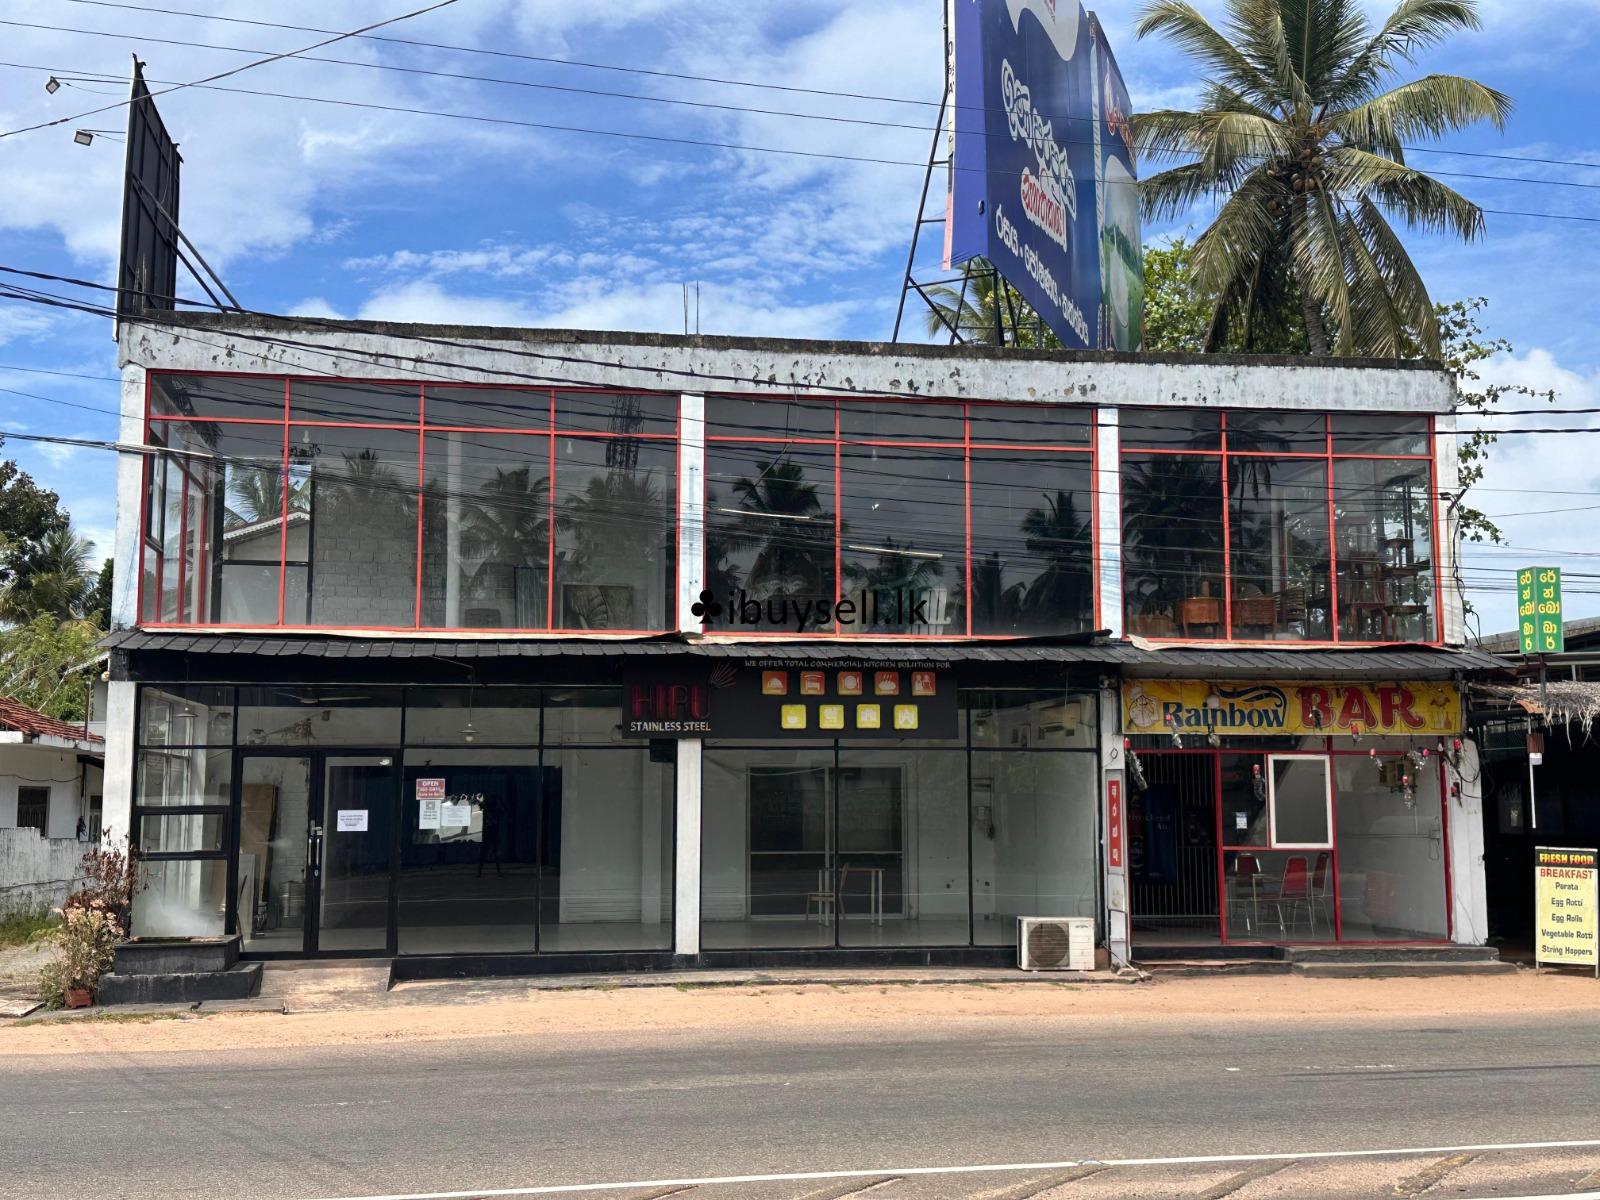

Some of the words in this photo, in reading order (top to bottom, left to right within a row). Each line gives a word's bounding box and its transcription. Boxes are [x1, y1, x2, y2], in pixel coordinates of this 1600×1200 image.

[995, 203, 1019, 258] රසය
[810, 660, 862, 668] COMMERCIAL
[1162, 701, 1286, 728] Rainbow
[1296, 686, 1426, 731] BAR
[630, 721, 681, 732] STAINLESS
[683, 721, 711, 732] STEEL
[1539, 853, 1568, 864] FRESH
[1569, 854, 1594, 865] FOOD
[1540, 868, 1594, 879] BREAKFAST
[1555, 881, 1579, 891] Parata
[1551, 897, 1564, 908] Egg
[1565, 898, 1583, 907] Rotti
[1551, 913, 1565, 923] Egg
[1566, 914, 1583, 923] Rolls
[1541, 928, 1575, 939] Vegetable
[1576, 930, 1593, 940] Rotti
[1541, 944, 1563, 955] String
